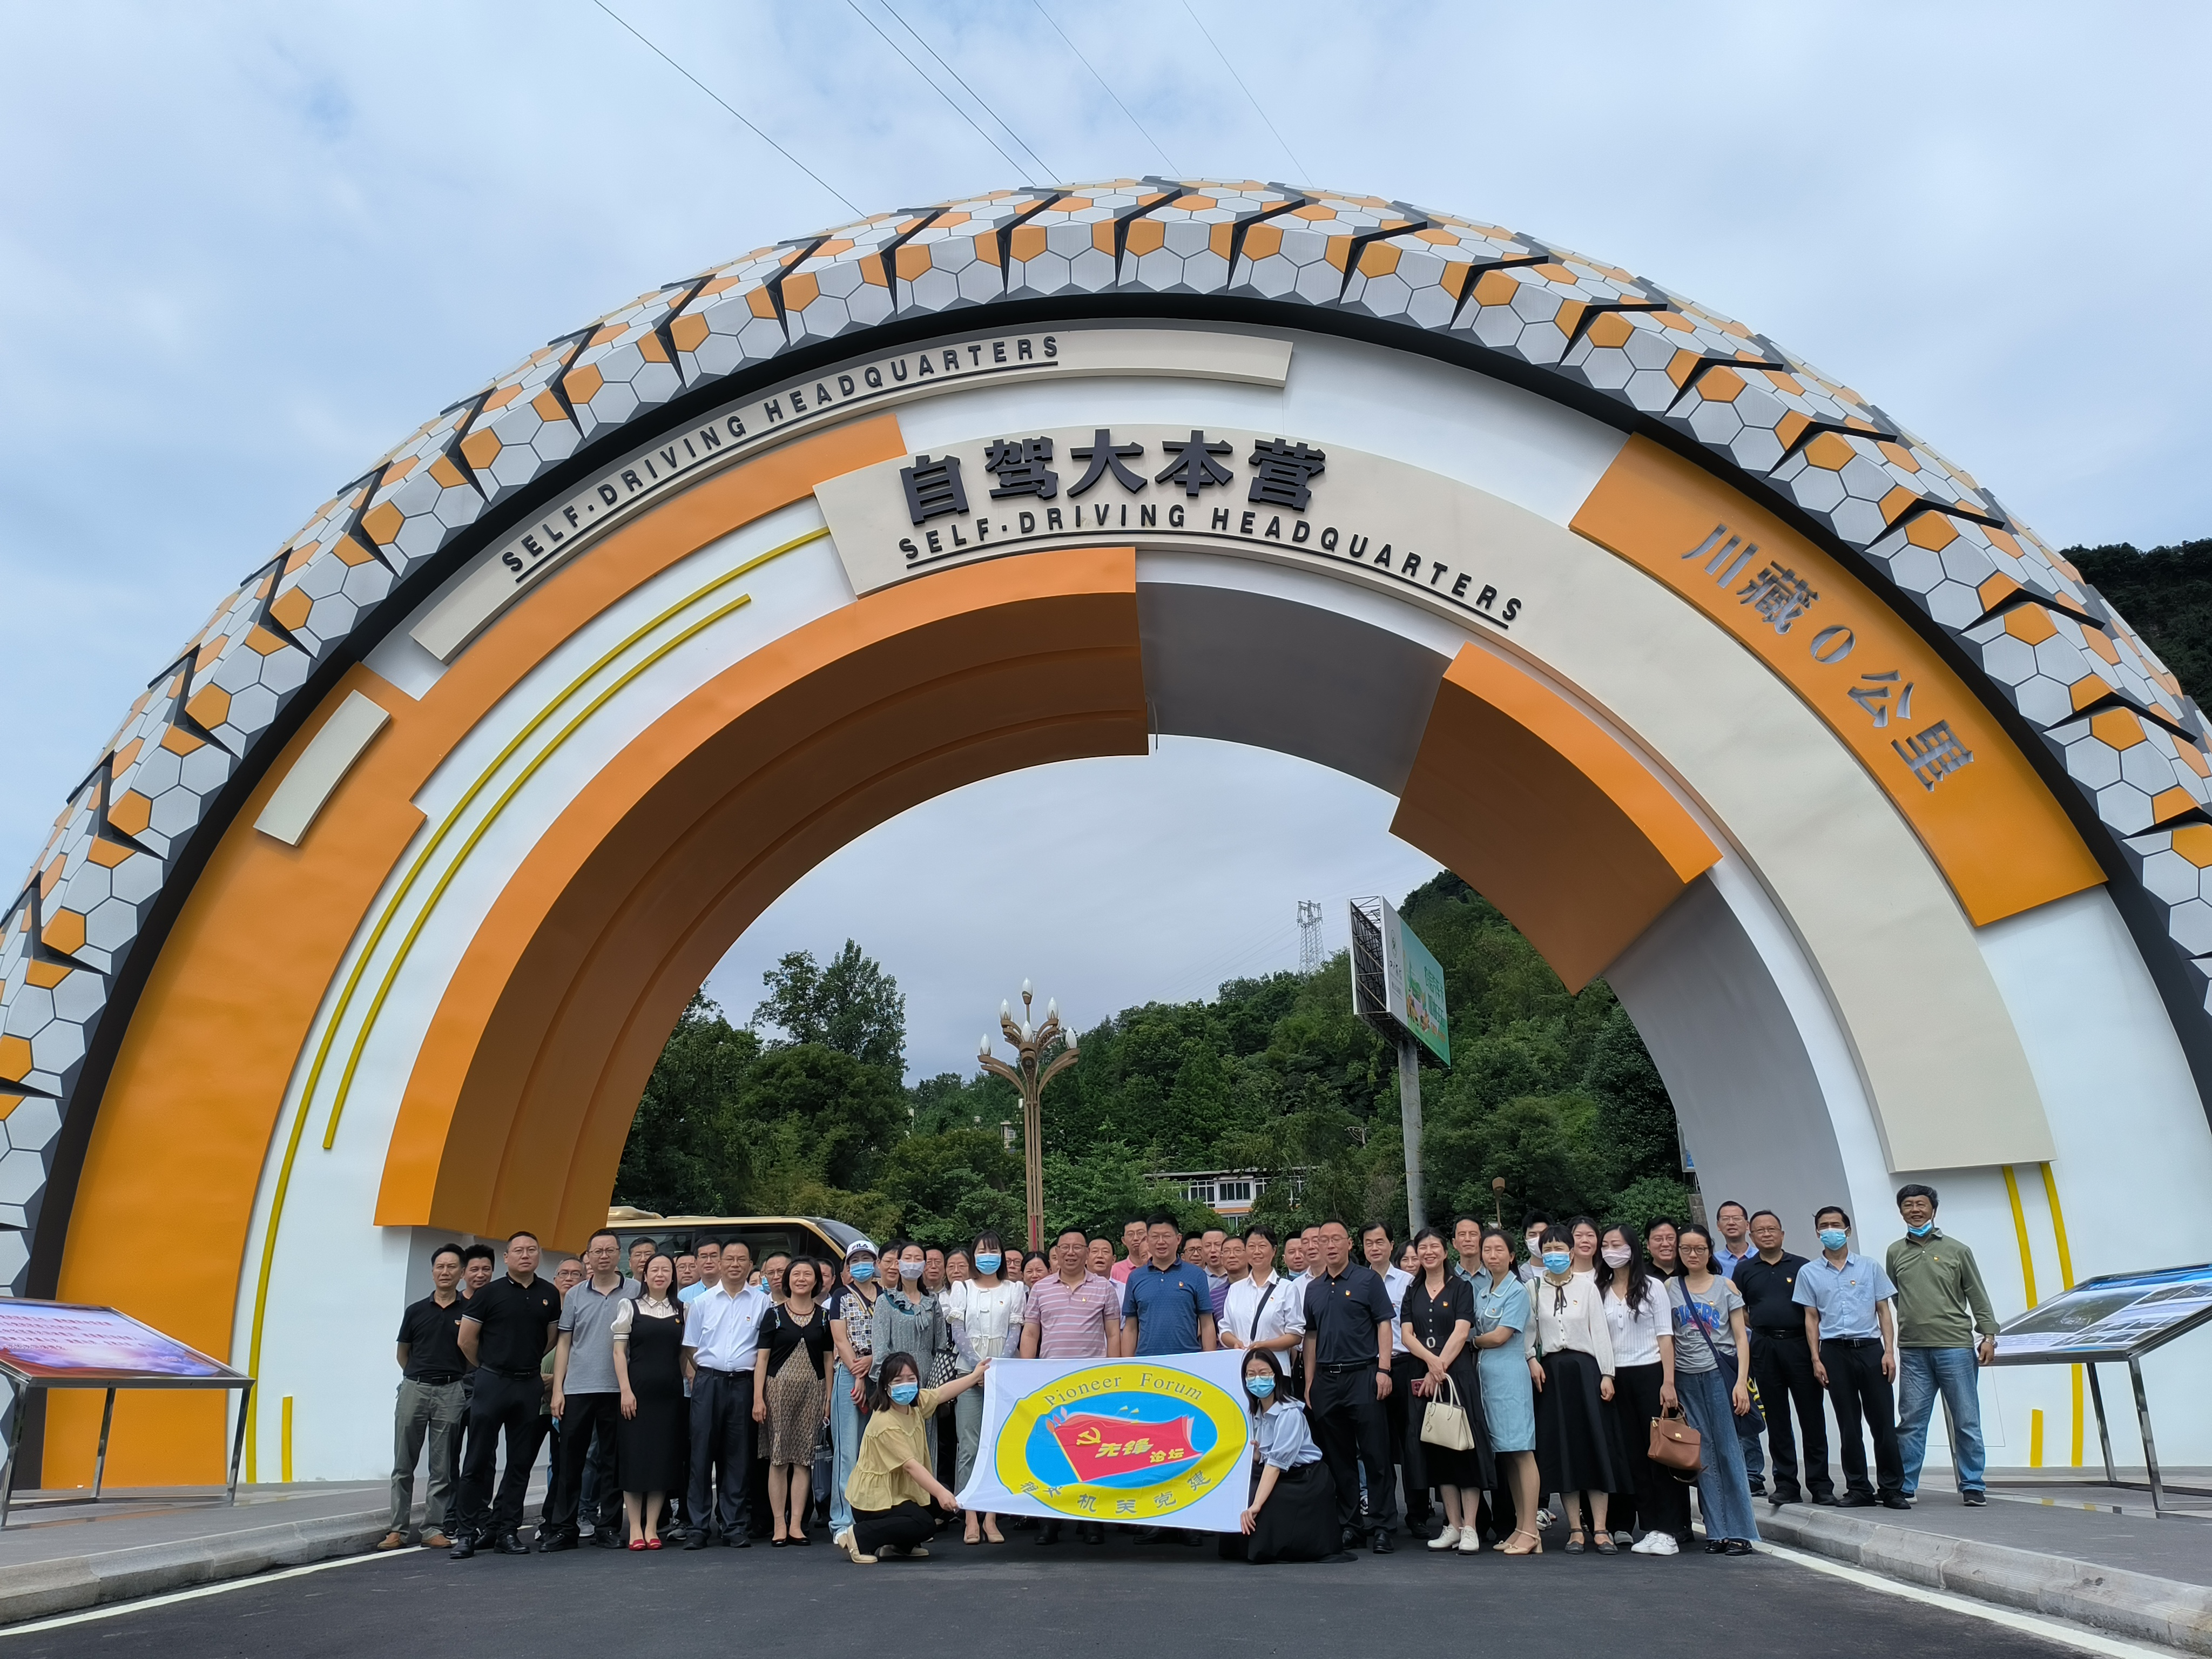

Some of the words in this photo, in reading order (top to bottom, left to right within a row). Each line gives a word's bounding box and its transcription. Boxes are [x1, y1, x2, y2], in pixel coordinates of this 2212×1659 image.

[764, 335, 1059, 422] HEADQUARTERS
[898, 428, 1327, 527] 自驾大本营
[1212, 507, 1522, 622] HEADQUARTERS
[1043, 1375, 1122, 1407] Pioneer
[1139, 1372, 1203, 1400] Forum
